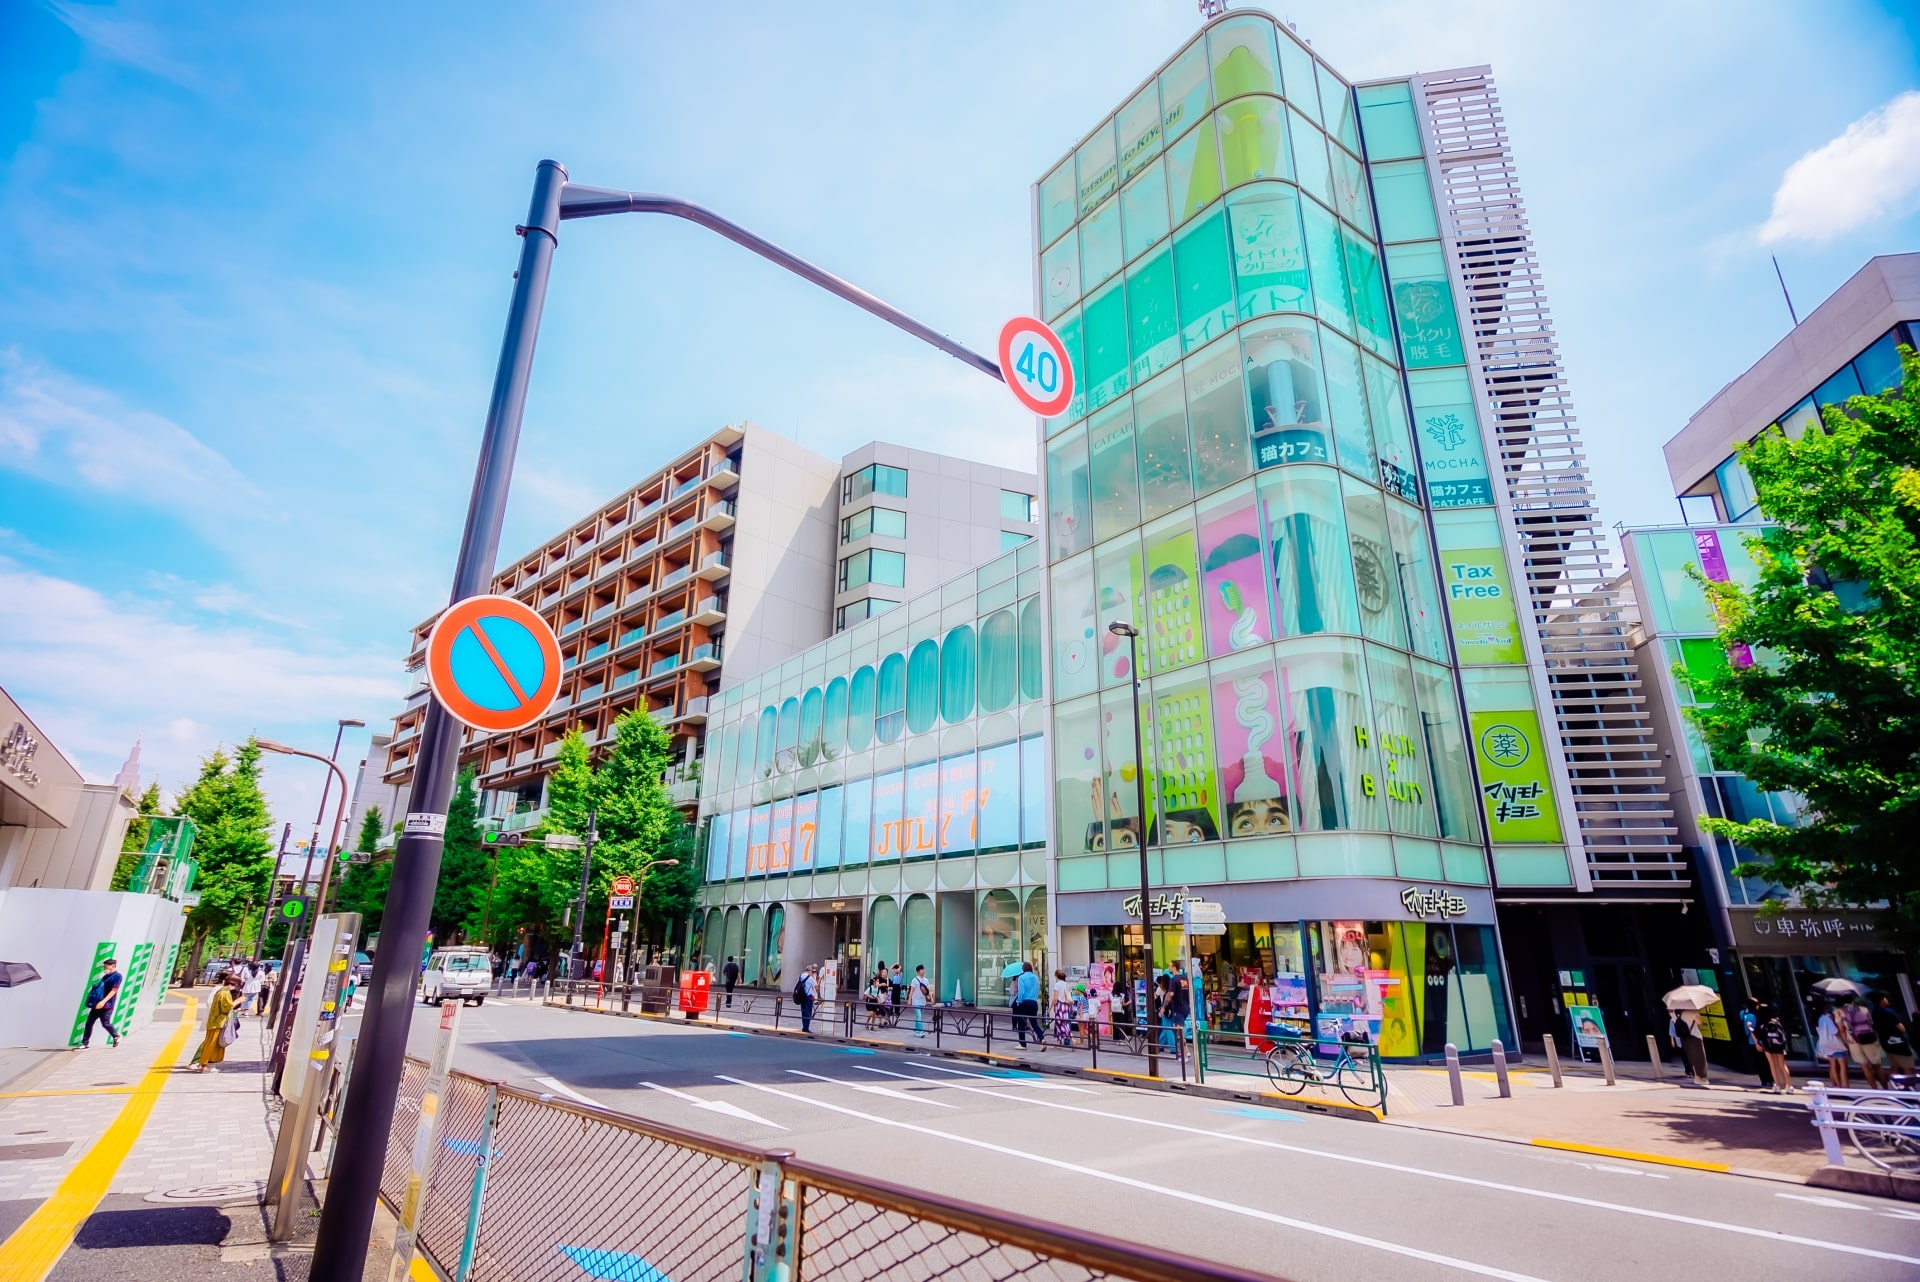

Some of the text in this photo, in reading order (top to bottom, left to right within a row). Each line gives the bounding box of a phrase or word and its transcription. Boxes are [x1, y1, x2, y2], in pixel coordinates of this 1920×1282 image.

[1410, 343, 1452, 360] 脱毛
[1016, 342, 1058, 393] 40
[1261, 441, 1326, 463] 猫カフェ
[1425, 457, 1480, 471] MOCHA
[1430, 484, 1484, 497] 猫カフェ
[1432, 497, 1486, 508] CAT CAFE
[1450, 564, 1494, 579] Tax
[1450, 583, 1502, 599] Free
[1354, 725, 1416, 758] HALTH
[1491, 732, 1521, 759] 薬
[1361, 774, 1424, 804] BAUTY
[1484, 782, 1544, 803] マツモト
[1496, 801, 1541, 823] キヨシ
[877, 811, 954, 856] JULY
[748, 822, 817, 872] JULY 7
[1400, 886, 1468, 919] マツモトキヨシ
[1776, 917, 1845, 938] 卑弥呼
